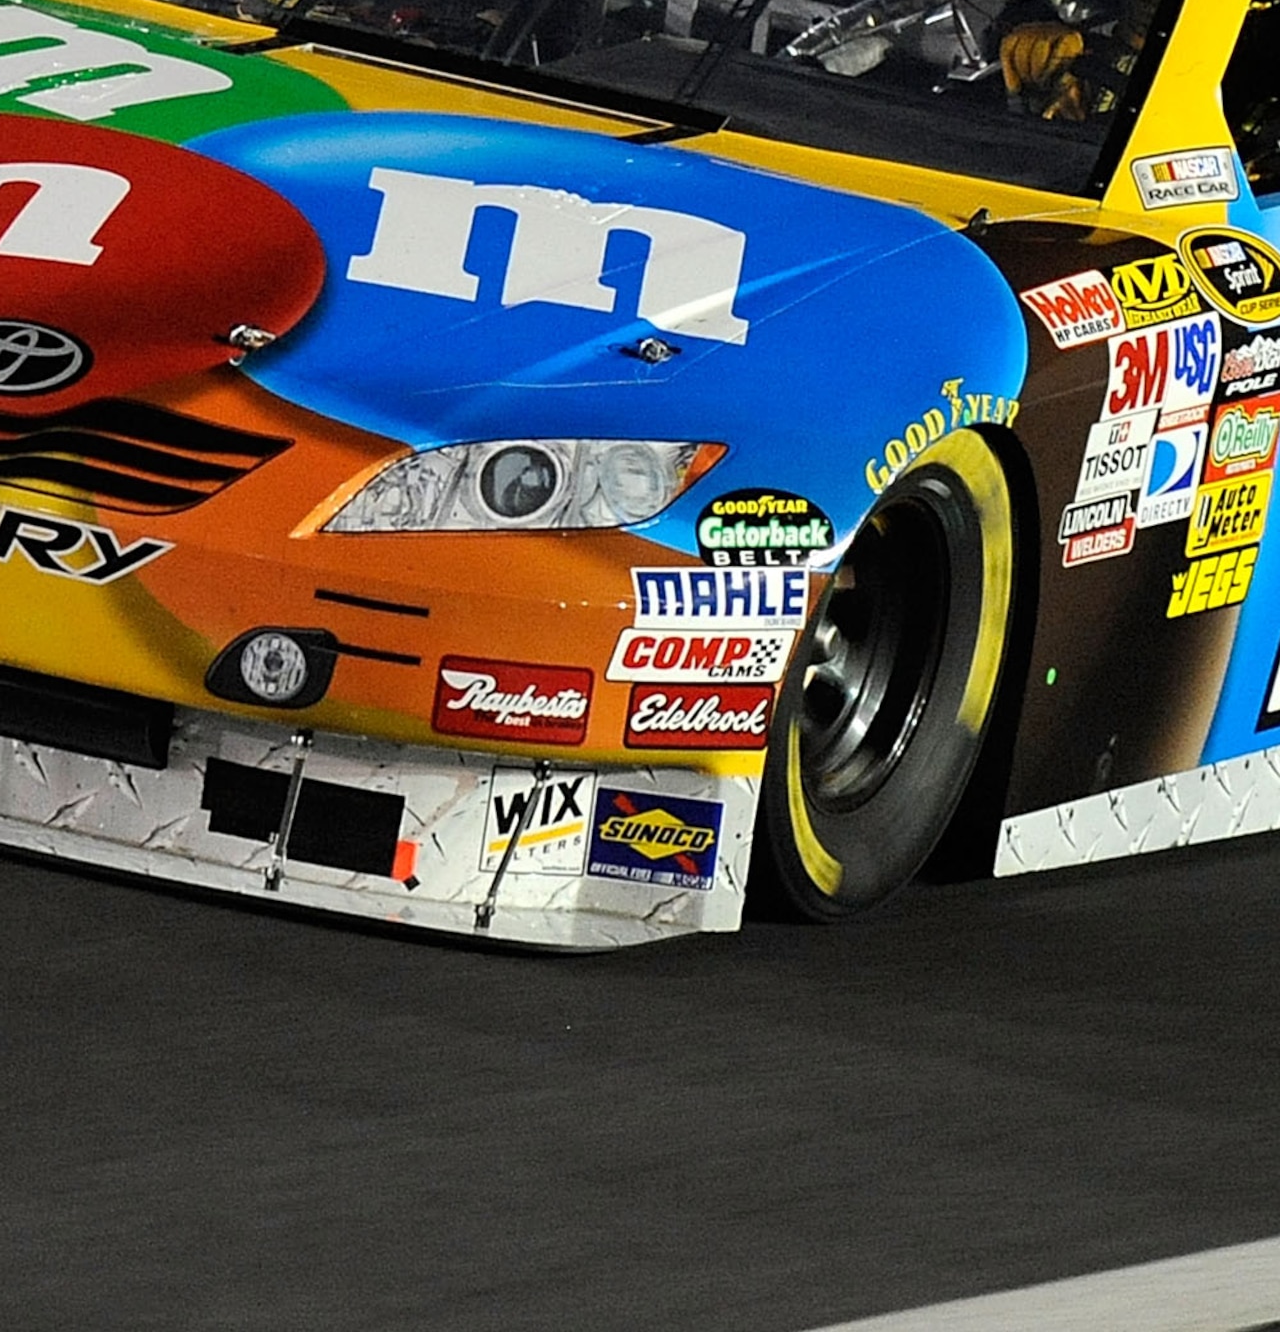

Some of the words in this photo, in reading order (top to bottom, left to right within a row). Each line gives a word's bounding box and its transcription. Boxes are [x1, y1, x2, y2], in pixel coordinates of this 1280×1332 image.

[1173, 155, 1220, 180] NASCAR
[1148, 184, 1193, 201] RACE
[1197, 180, 1229, 196] CAR
[346, 166, 749, 345] m
[1223, 262, 1262, 295] Sprint
[1025, 281, 1121, 329] Holley
[1239, 300, 1258, 316] CUP
[1055, 325, 1071, 342] HP
[1073, 320, 1112, 338] CARBS
[1108, 329, 1169, 415] 3M
[1224, 372, 1279, 397] POLE
[1215, 410, 1277, 460] O'Reilly
[1084, 443, 1148, 481] TISSOT
[712, 496, 808, 517] GOODYEAR
[1140, 496, 1191, 524] DIRECTV
[1214, 483, 1258, 514] Auto
[698, 516, 830, 549] Gatorback
[1063, 497, 1128, 537] LINCOLN
[1210, 508, 1262, 540] Meter
[1070, 528, 1128, 560] WELDERS
[635, 570, 806, 617] MAHLE
[1165, 546, 1260, 619] JEGS
[621, 636, 753, 670] COMP
[707, 664, 768, 678] CAMS
[440, 670, 589, 724] Raybestos
[629, 692, 768, 735] Edelbrock
[493, 776, 585, 836] WIX
[487, 835, 582, 867] FLTERS
[603, 819, 710, 850] SUNOCO
